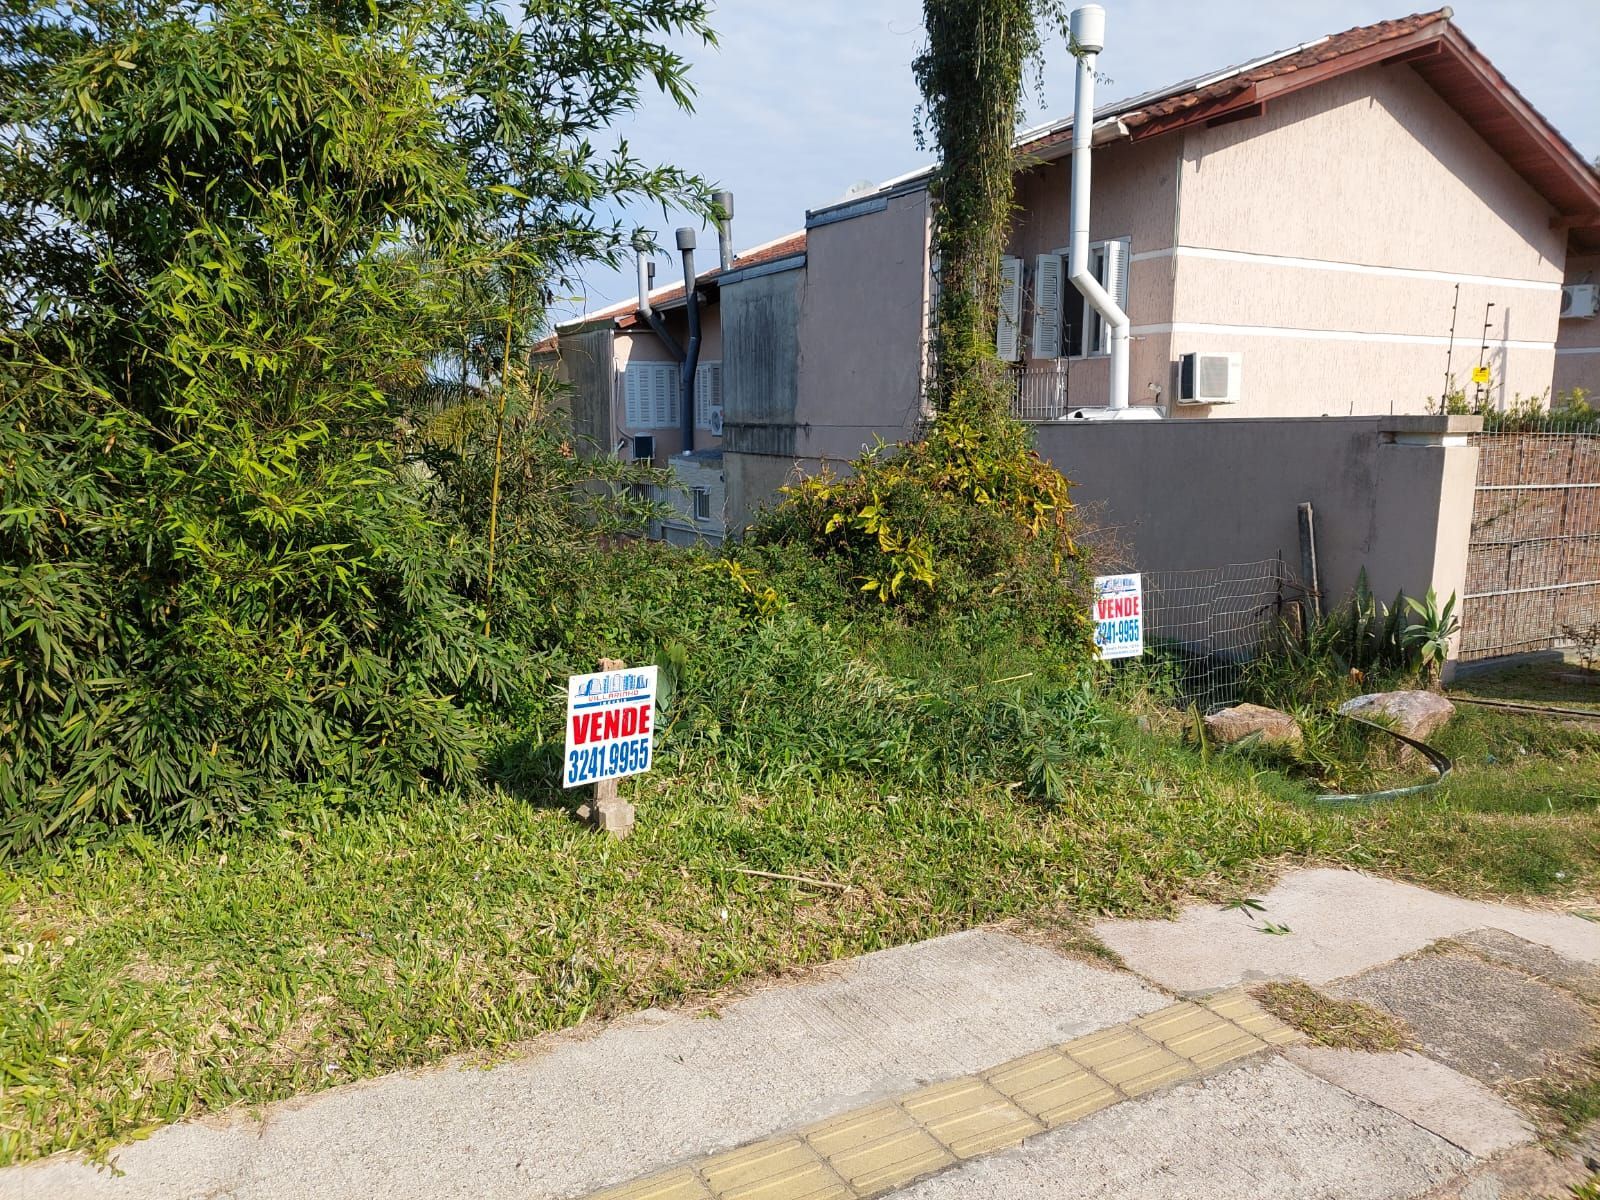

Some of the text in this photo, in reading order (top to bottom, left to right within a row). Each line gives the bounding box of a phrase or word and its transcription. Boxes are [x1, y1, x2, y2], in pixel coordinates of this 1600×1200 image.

[1097, 596, 1140, 620] VENDE
[572, 703, 651, 745] VENDE
[568, 737, 649, 784] 3241.9955
